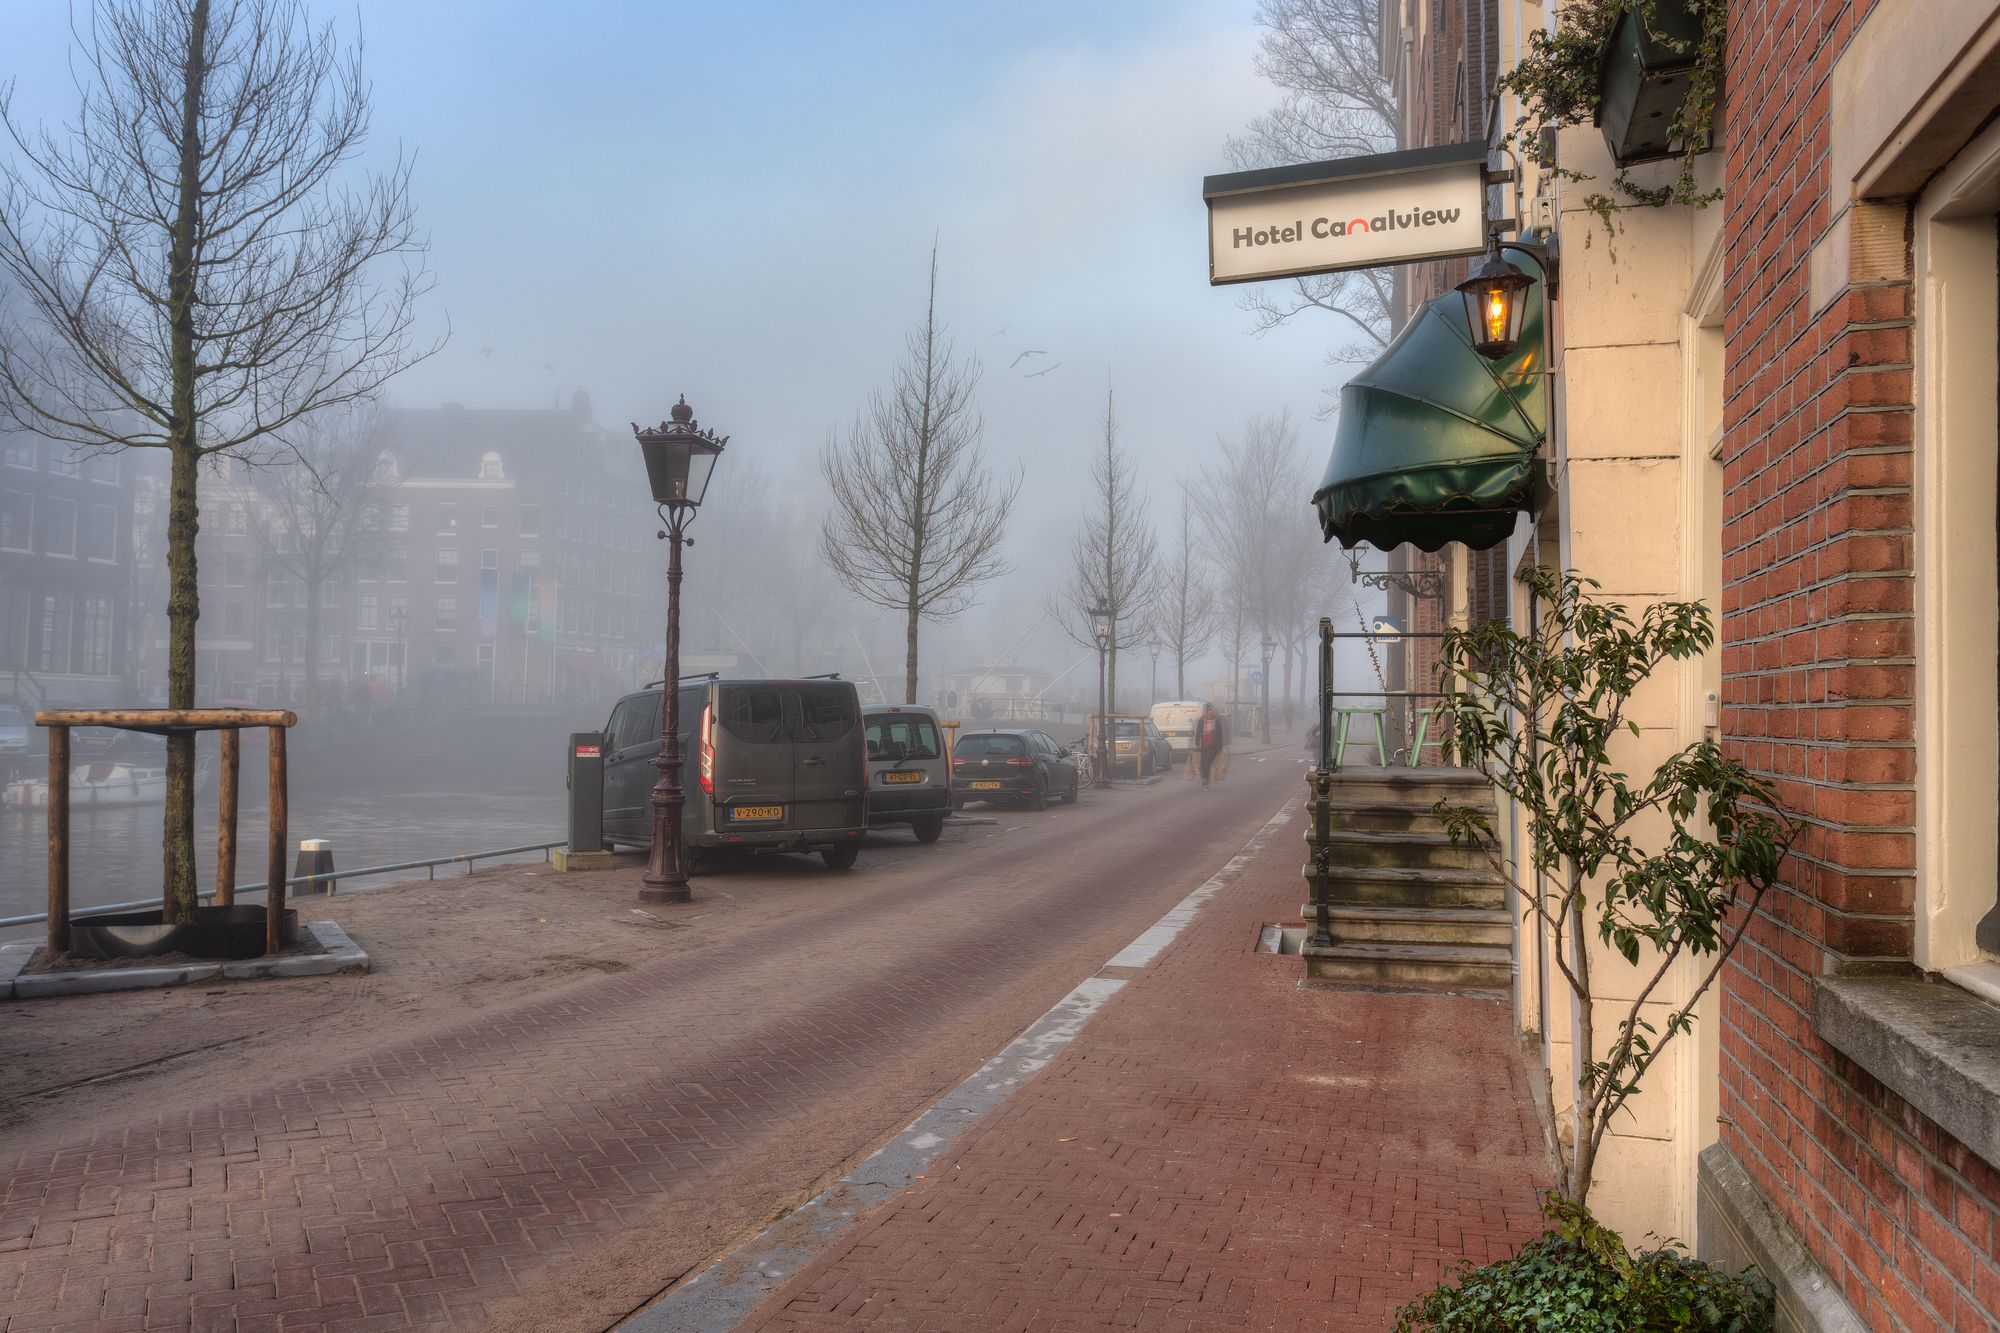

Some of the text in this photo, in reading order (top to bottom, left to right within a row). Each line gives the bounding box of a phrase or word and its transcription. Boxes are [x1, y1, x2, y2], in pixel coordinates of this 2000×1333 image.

[1233, 207, 1461, 249] Hotel Canalview
[736, 807, 779, 818] V-290-KD
